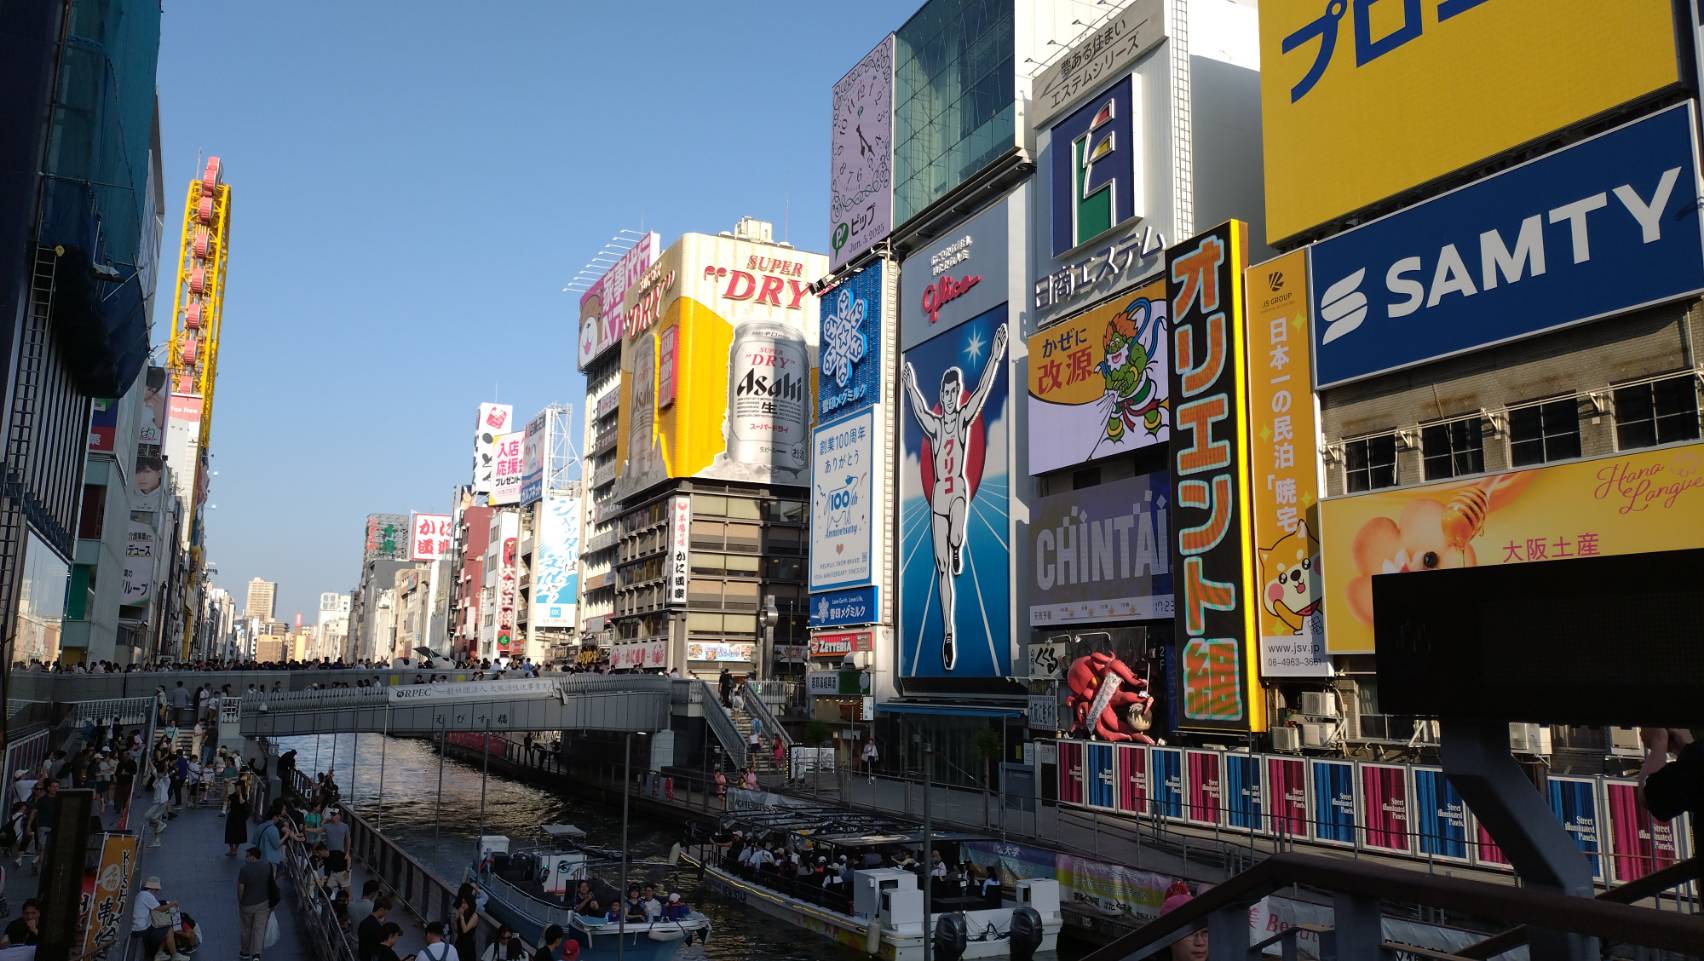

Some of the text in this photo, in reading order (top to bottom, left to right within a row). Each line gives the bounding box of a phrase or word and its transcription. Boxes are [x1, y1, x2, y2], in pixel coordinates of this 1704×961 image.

[851, 203, 877, 237] ピップ
[1384, 166, 1682, 318] SAMTY
[749, 254, 804, 280] SUPER
[1035, 225, 1167, 312] 日商エステム
[922, 275, 982, 325] Glico
[1042, 328, 1087, 358] かぜに
[736, 367, 803, 402] Asahi
[1038, 347, 1093, 394] 改源
[762, 401, 778, 416] 生
[819, 426, 866, 456] 創業100周年
[824, 450, 859, 474] ありがとう
[944, 434, 959, 494] グリコ
[1593, 462, 1664, 501] Hana
[1036, 490, 1169, 592] CHINTAI
[1502, 531, 1600, 563] 大阪土産
